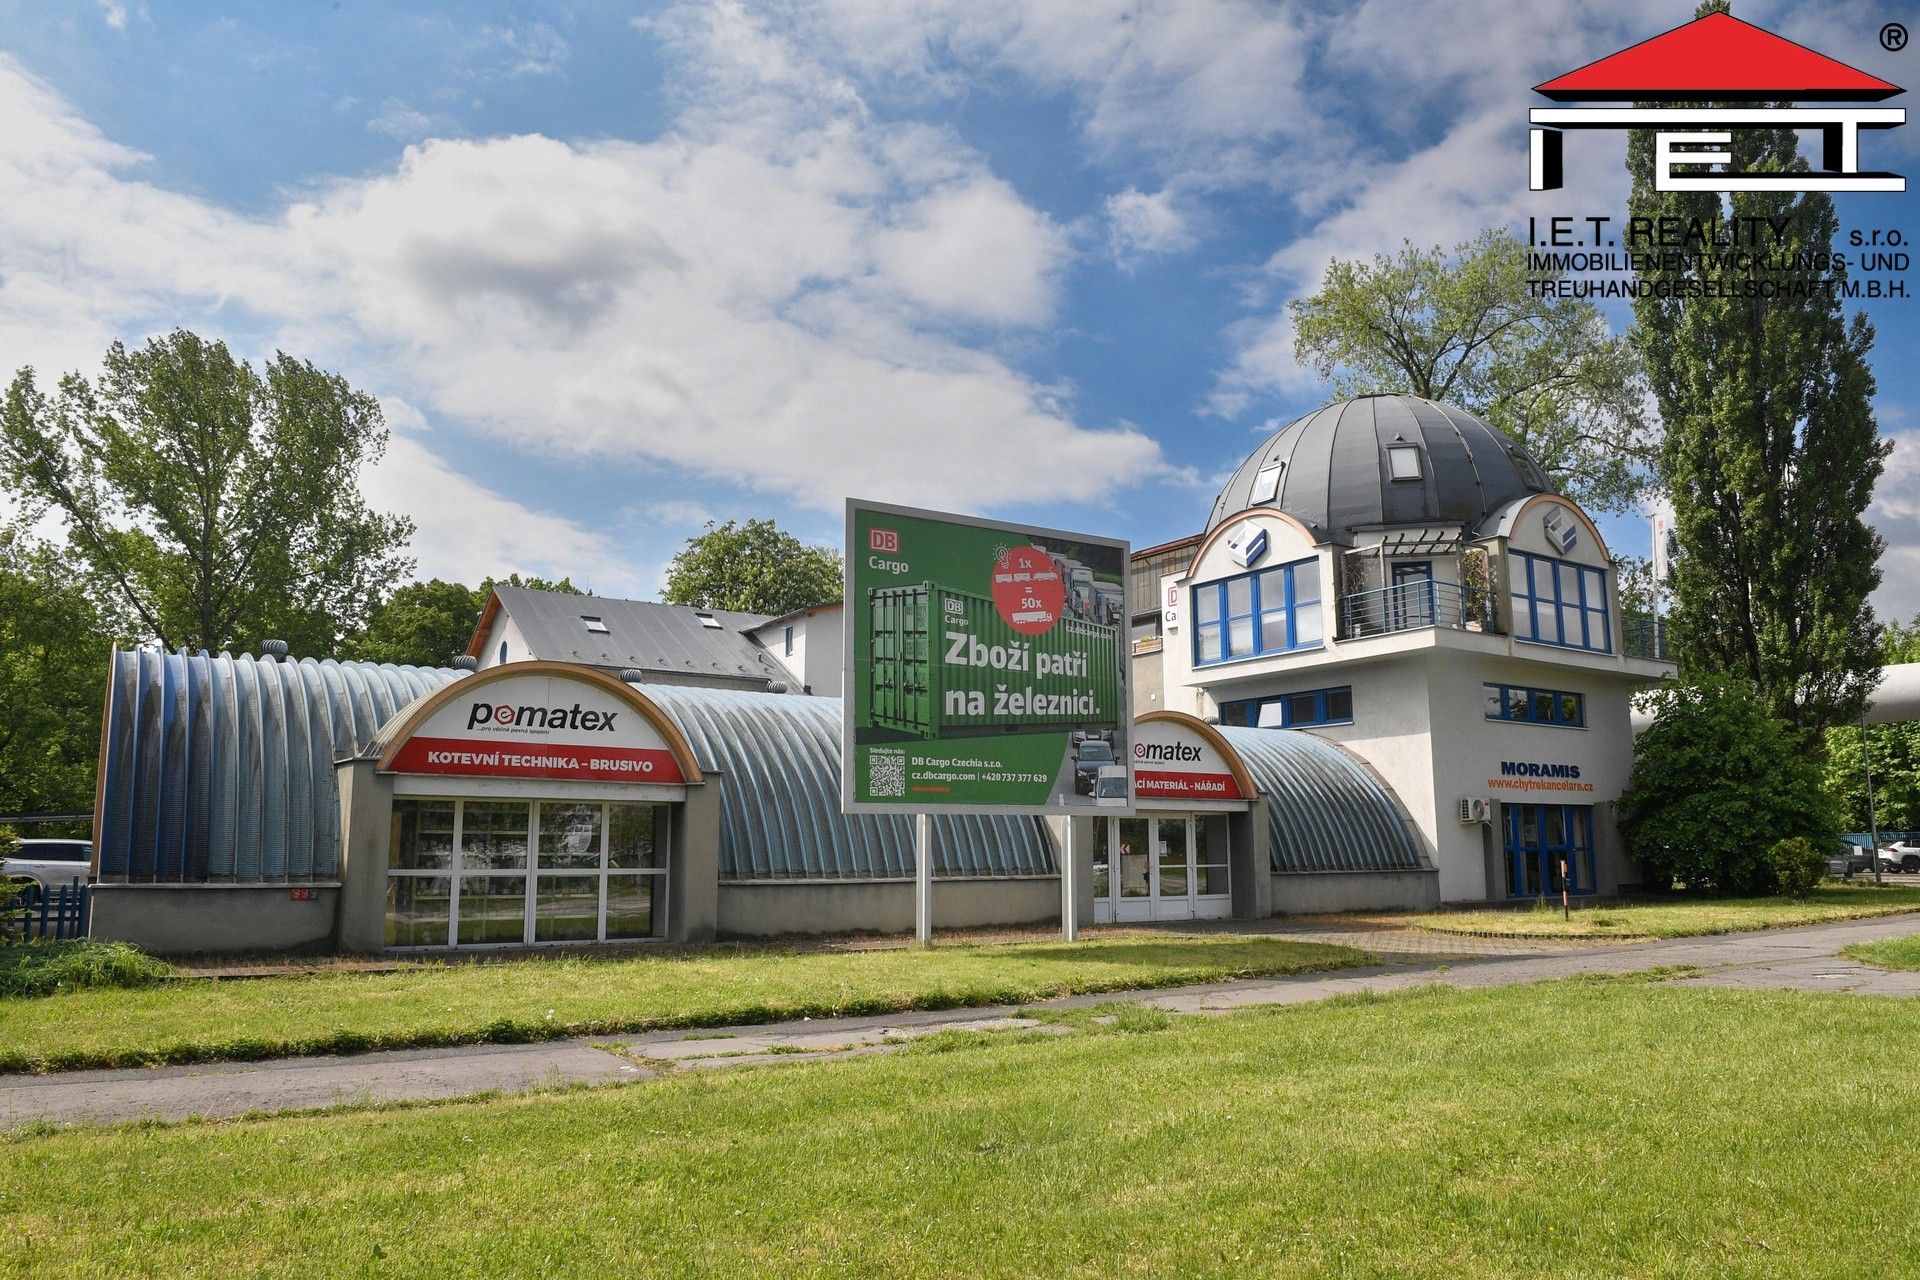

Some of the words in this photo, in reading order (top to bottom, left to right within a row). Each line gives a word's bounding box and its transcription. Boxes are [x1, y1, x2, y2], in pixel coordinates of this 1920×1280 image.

[871, 530, 898, 551] DB
[868, 556, 909, 575] Cargo
[1019, 558, 1032, 569] 1x
[946, 599, 962, 612] DB
[1021, 598, 1042, 609] 50x
[944, 614, 969, 627] Cargo
[1165, 611, 1177, 622] Ca
[945, 631, 1029, 672] Zboží
[1036, 651, 1088, 679] patří
[945, 689, 985, 715] na
[993, 684, 1101, 715] železnici.
[428, 751, 499, 765] KOTEVNÍ
[502, 755, 579, 769] TECHNIKA
[590, 761, 653, 773] BRUSIVO
[911, 757, 924, 766] DB
[925, 757, 950, 768] Cargo
[951, 758, 982, 768] Czechia
[983, 760, 1003, 768] s.r.o.
[1500, 761, 1581, 779] MORAMIS
[911, 771, 976, 782] cz.dbcargo.com
[981, 772, 1001, 781] +420
[1001, 773, 1016, 782] 737
[1017, 773, 1033, 782] 377
[1033, 774, 1048, 783] 629
[1146, 779, 1189, 790] MATERIÁL
[1194, 780, 1226, 791] NÁŘADÍ
[1487, 778, 1594, 792] www.chytrekancelare.cz
